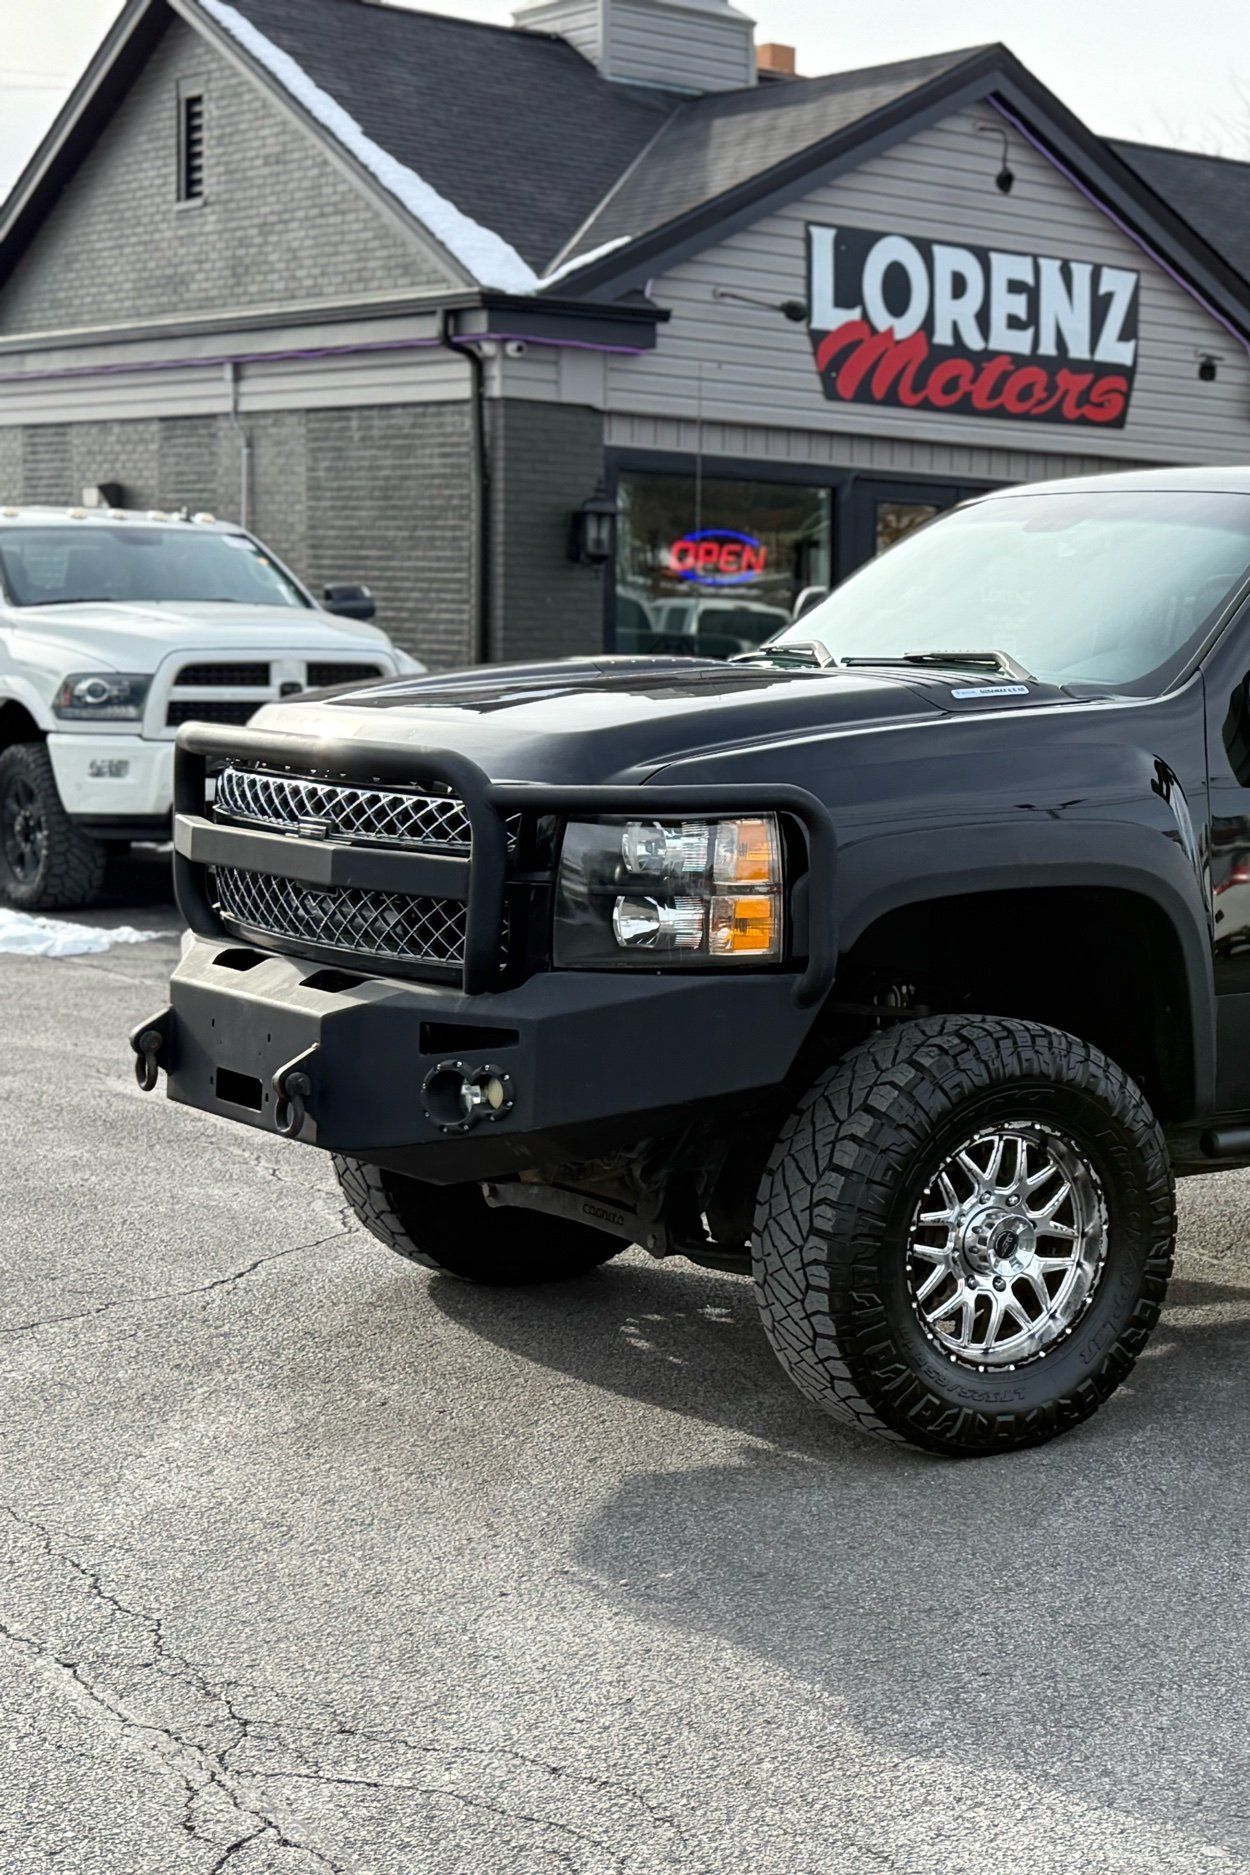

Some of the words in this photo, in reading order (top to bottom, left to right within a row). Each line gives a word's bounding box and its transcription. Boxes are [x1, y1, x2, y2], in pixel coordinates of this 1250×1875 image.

[808, 225, 1139, 366] LORENZ
[817, 320, 1129, 422] Motors
[668, 540, 768, 574] OPEN
